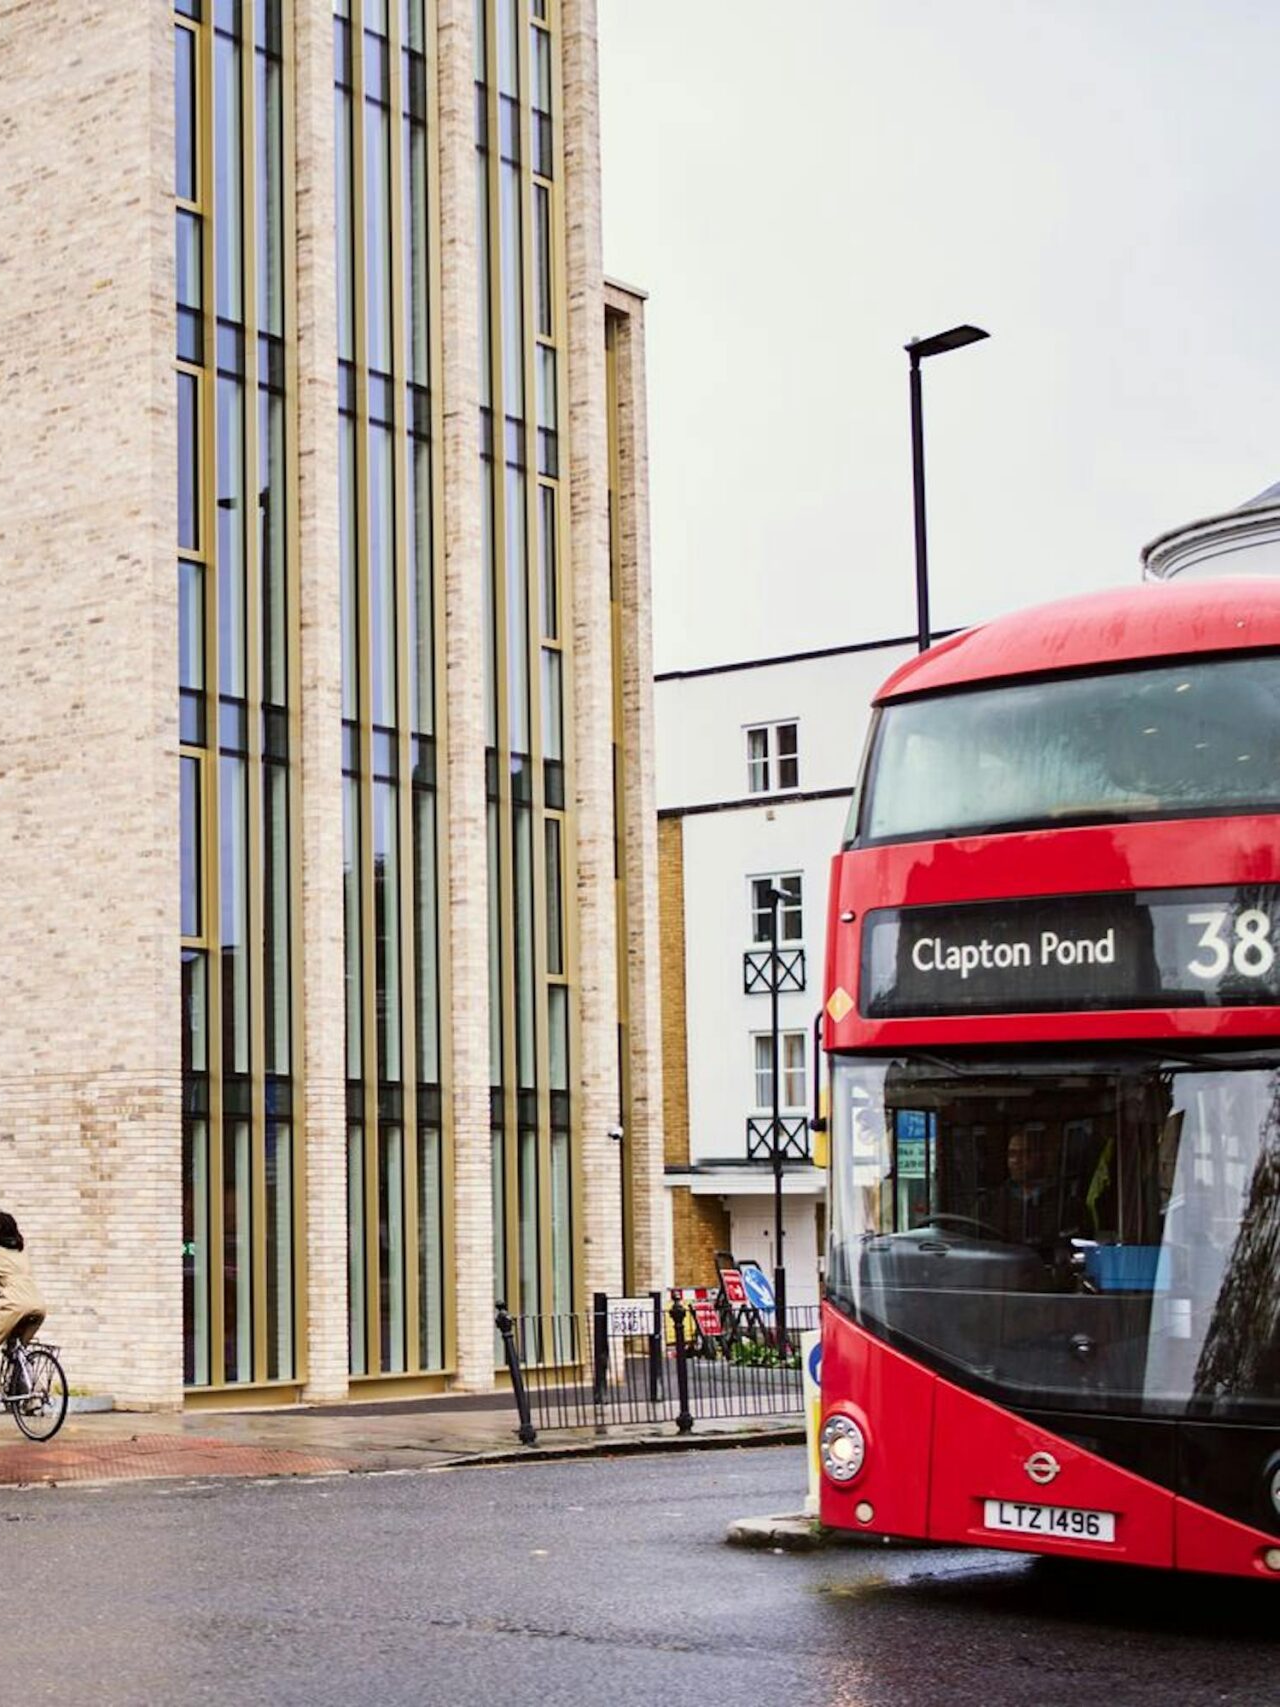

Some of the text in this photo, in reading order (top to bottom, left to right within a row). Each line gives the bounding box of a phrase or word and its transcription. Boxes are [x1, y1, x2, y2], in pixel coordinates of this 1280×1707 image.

[912, 928, 1116, 979] Clapton Pond
[1187, 909, 1274, 979] 38
[999, 1501, 1100, 1536] LTZ 1496
